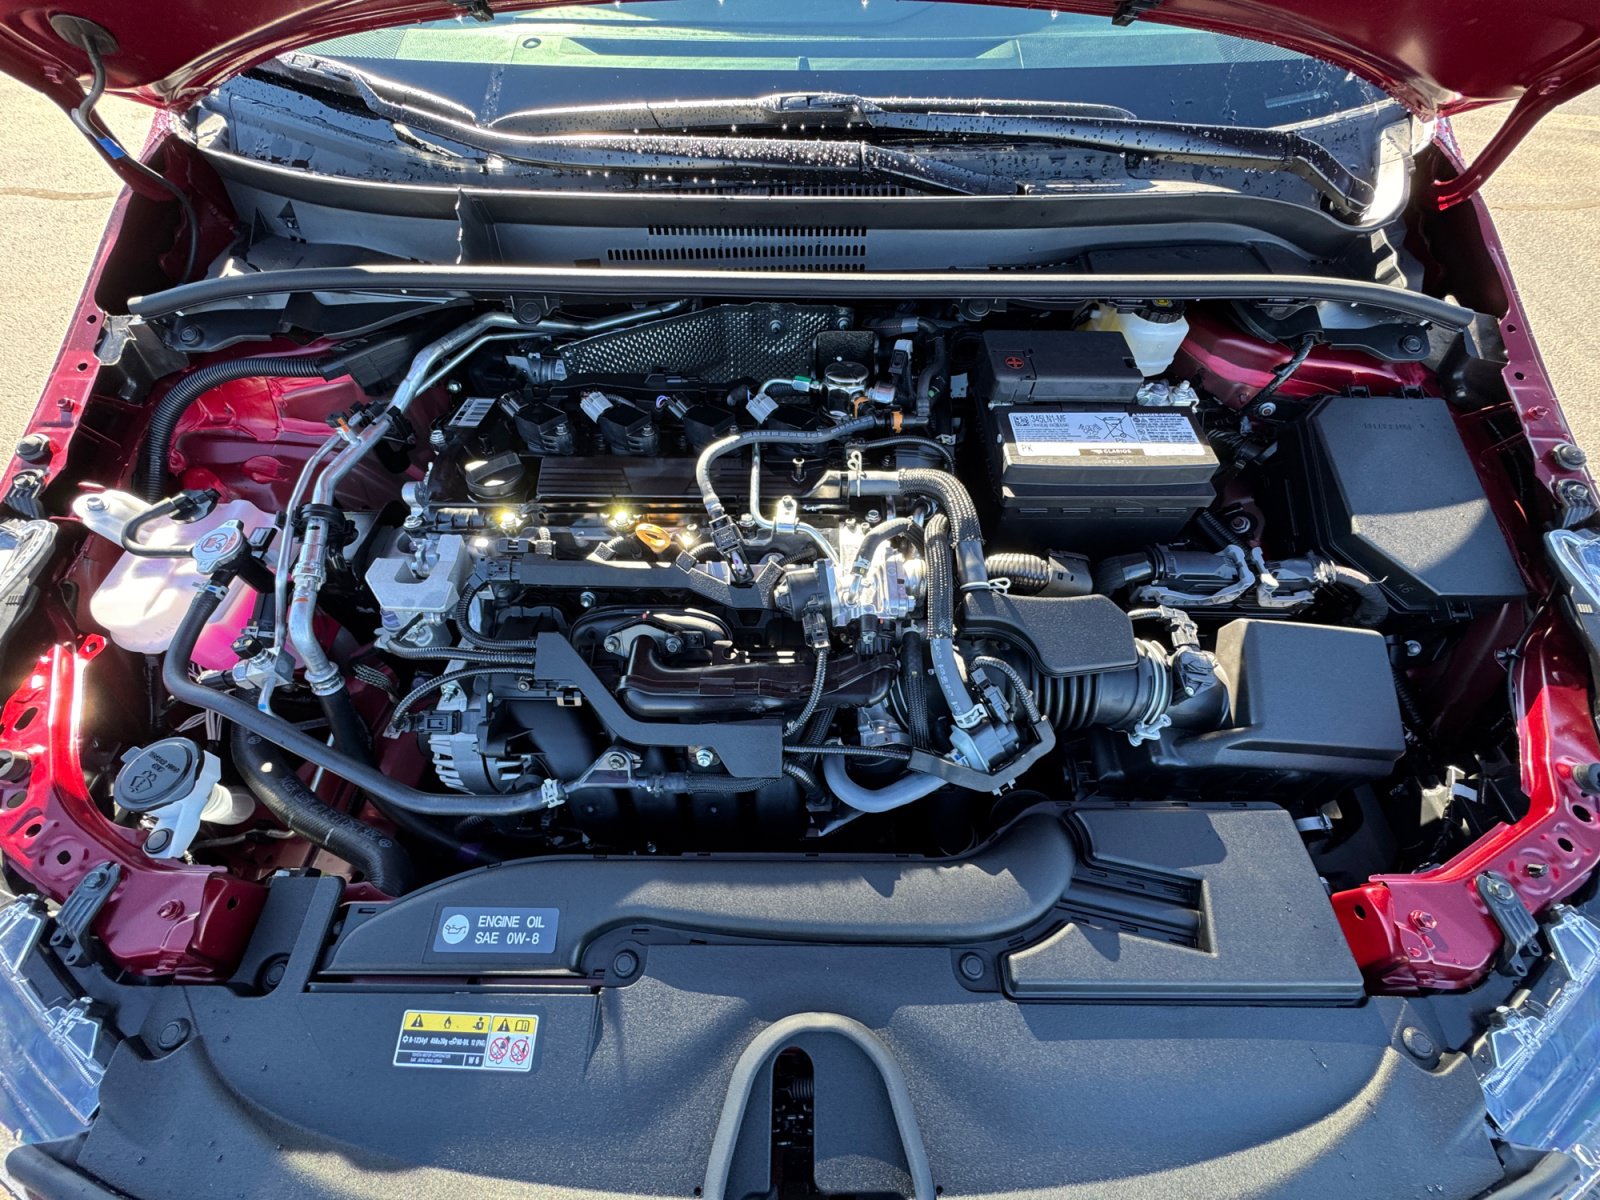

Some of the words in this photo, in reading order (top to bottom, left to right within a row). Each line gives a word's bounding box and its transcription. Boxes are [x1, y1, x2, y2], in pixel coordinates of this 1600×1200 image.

[478, 915, 521, 928] ENGINE
[526, 916, 545, 929] OIL
[474, 931, 500, 945] SAE
[506, 932, 541, 945] 0W-8
